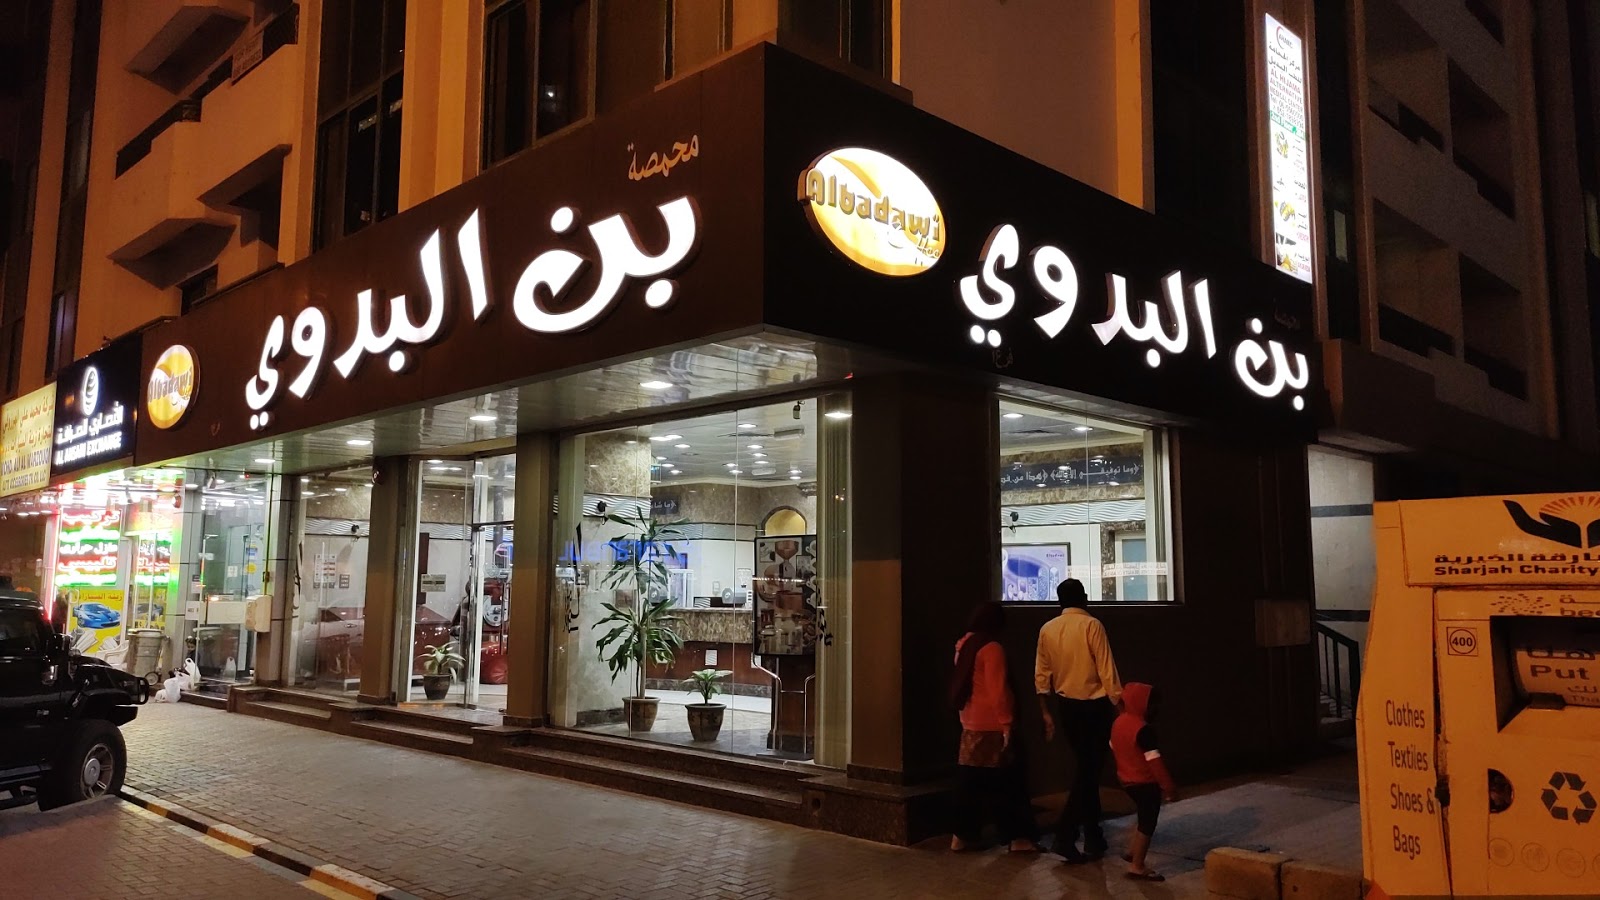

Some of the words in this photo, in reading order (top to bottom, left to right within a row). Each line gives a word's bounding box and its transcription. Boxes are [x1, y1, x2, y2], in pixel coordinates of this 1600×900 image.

[628, 134, 699, 181] محمصة
[806, 167, 940, 242] Albadawi
[513, 197, 697, 334] بن
[960, 223, 1216, 368] البدوي
[245, 207, 489, 430] البدوي
[1235, 318, 1309, 410] بن
[87, 431, 122, 455] EXCHANGE
[1435, 564, 1512, 576] Sharjah
[1519, 564, 1599, 576] Charity
[1452, 636, 1473, 647] 400
[1530, 664, 1590, 680] Put
[1386, 700, 1425, 728] Clothes
[1388, 741, 1428, 771] Textiles
[1390, 783, 1423, 813] Shoes
[1427, 787, 1435, 815] &
[1393, 825, 1421, 860] Bags
